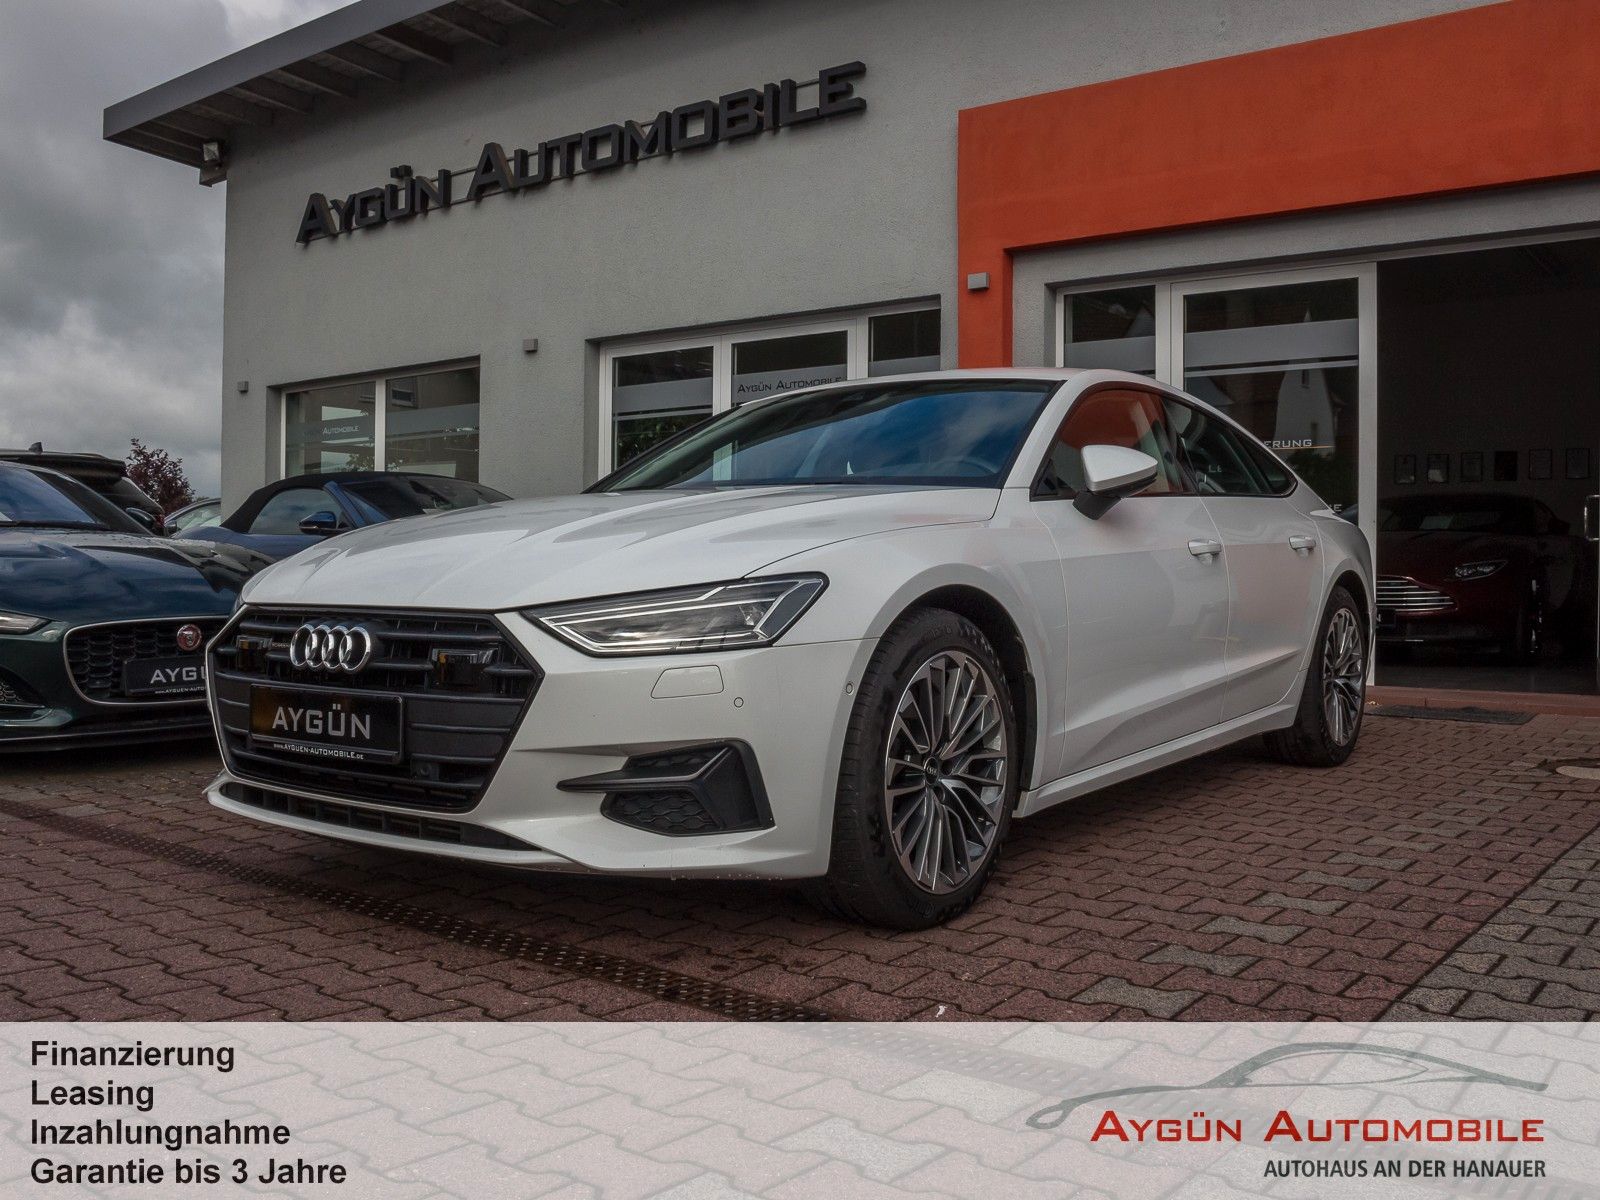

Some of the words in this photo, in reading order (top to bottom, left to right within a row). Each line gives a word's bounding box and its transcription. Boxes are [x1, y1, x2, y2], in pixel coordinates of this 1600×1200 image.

[296, 165, 452, 244] AYGÜN
[466, 60, 868, 202] AUTOMOBILE
[737, 381, 772, 393] AYGÜN
[272, 703, 370, 740] AYGÜN
